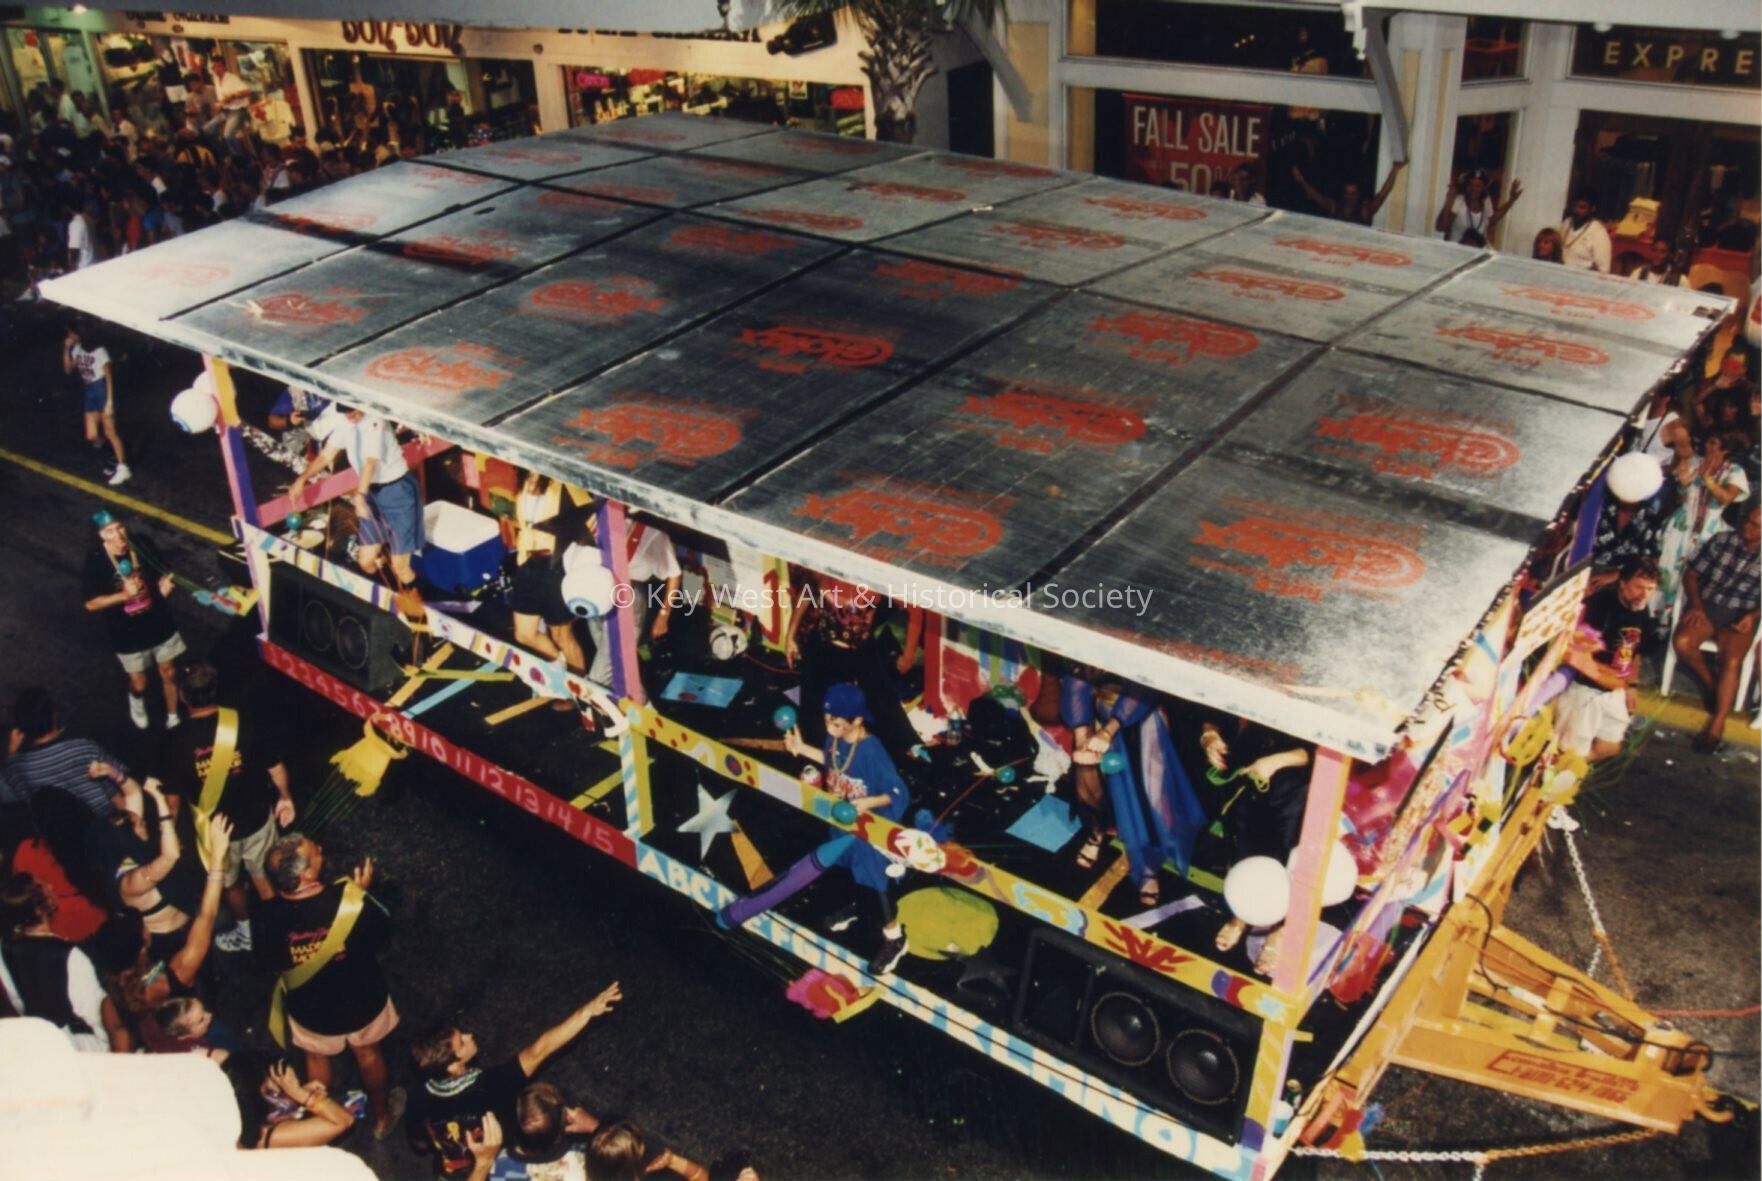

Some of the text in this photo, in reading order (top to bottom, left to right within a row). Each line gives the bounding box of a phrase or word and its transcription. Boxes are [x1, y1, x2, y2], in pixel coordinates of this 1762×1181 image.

[1603, 41, 1756, 75] EXPRE
[1133, 105, 1261, 159] FALL SALE
[353, 691, 366, 718] 6
[403, 720, 416, 745] 9
[422, 731, 448, 763] 10
[456, 751, 471, 774] 11
[481, 764, 505, 793] 12
[516, 784, 540, 814] 13
[548, 801, 572, 831] 14
[583, 821, 614, 854] 15
